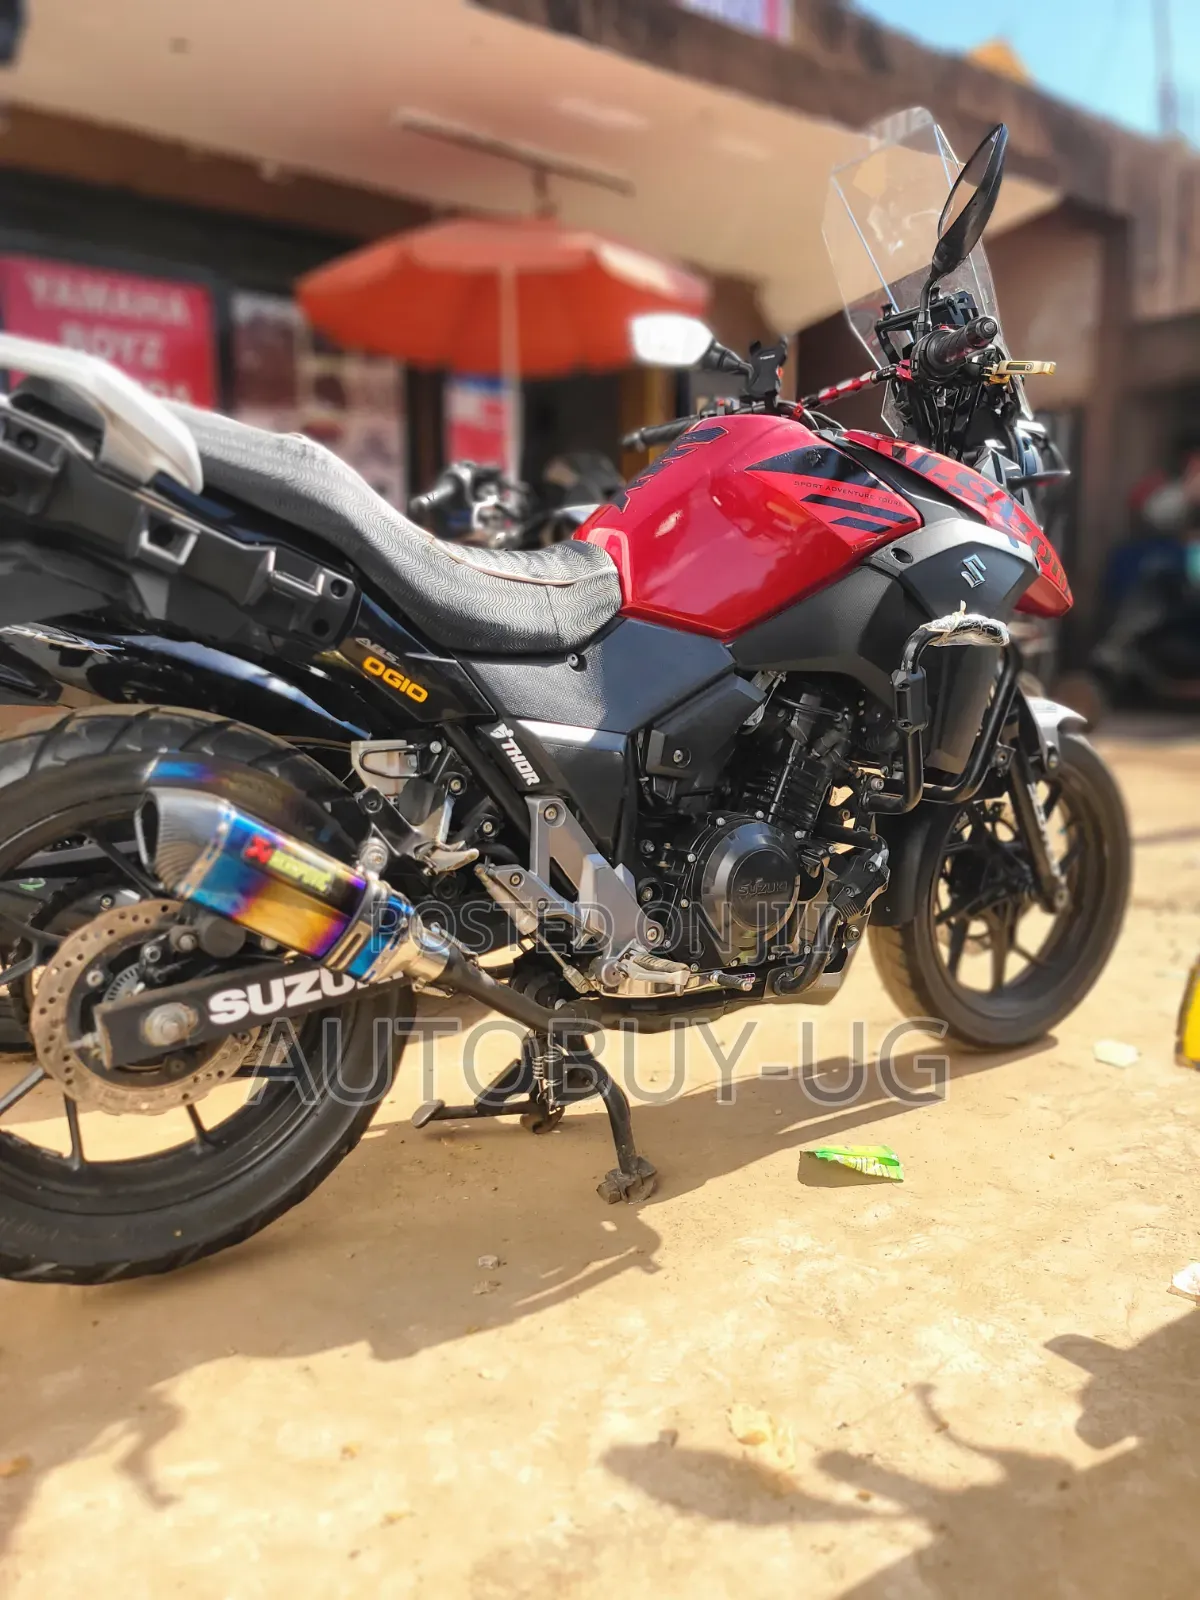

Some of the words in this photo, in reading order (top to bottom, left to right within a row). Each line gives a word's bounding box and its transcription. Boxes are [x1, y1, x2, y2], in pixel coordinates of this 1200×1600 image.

[794, 480, 822, 489] SPORT
[825, 485, 875, 500] ADVENTURE
[363, 656, 429, 703] OGIO
[501, 738, 540, 786] THOR
[739, 877, 788, 896] SUZUKI
[208, 965, 404, 1026] SUZU
